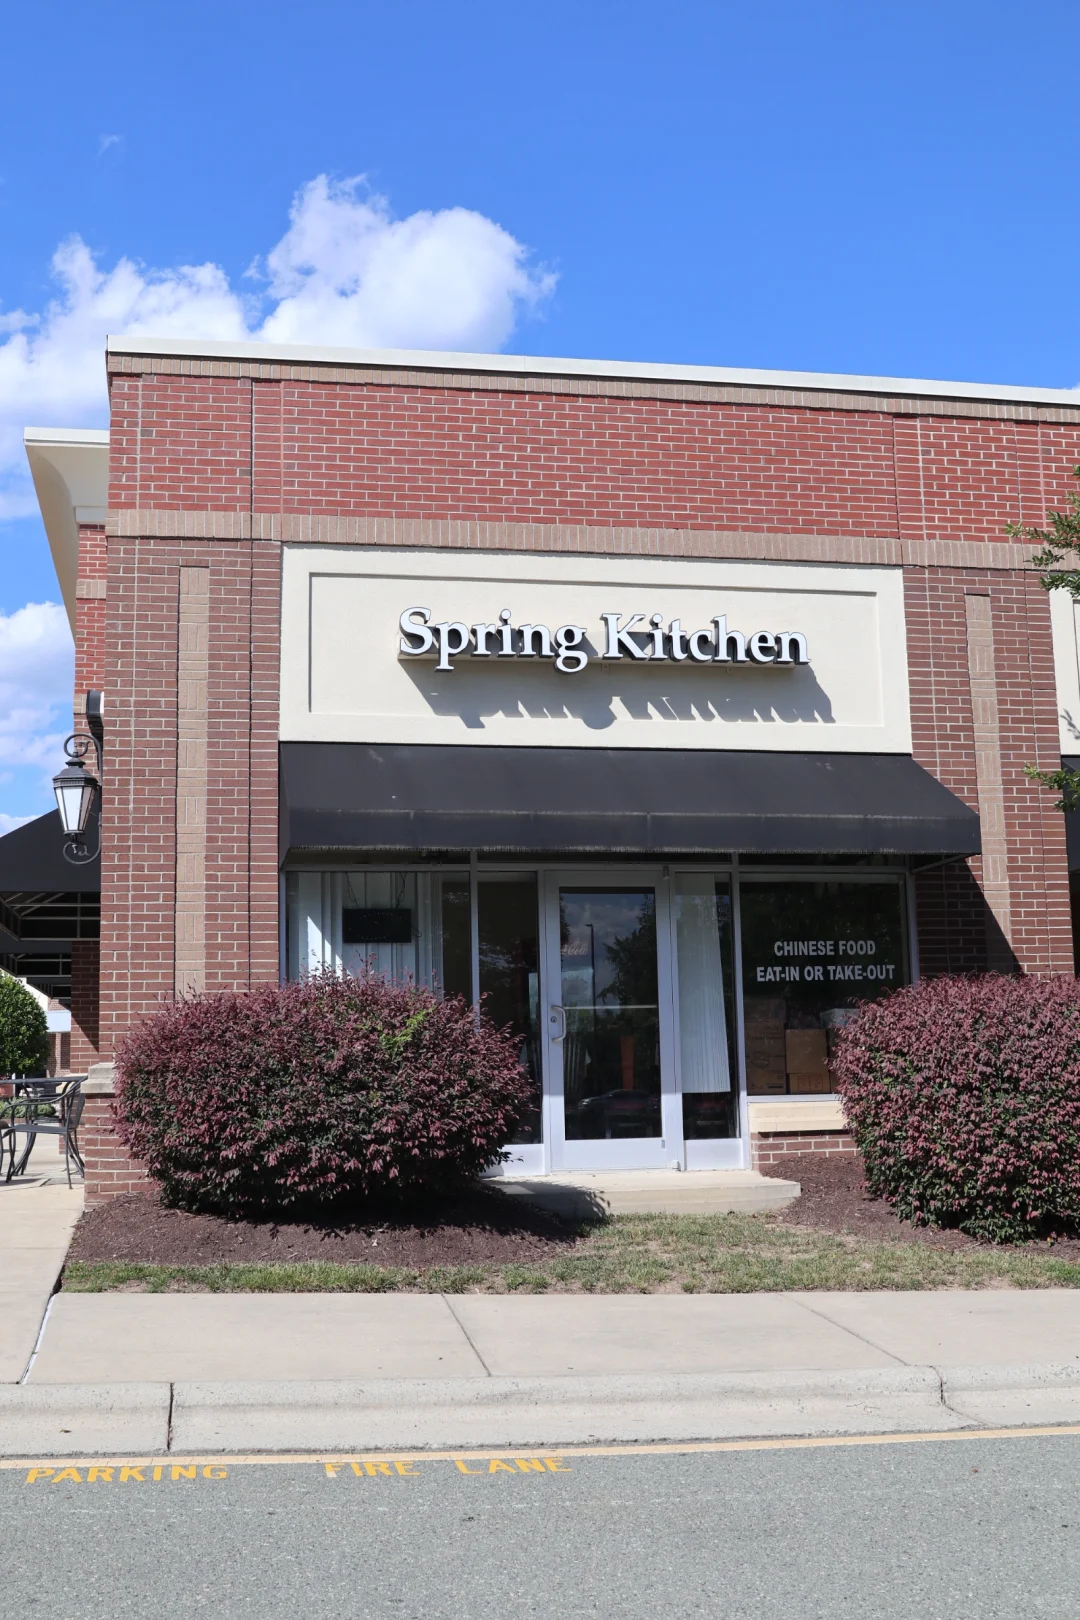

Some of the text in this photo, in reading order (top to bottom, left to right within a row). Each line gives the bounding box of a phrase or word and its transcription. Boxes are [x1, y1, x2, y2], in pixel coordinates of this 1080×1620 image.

[399, 606, 811, 674] Spring Kitchen
[773, 940, 876, 957] CHINESE FOOD
[756, 964, 895, 982] EAT-IN OR TAKE-OUT
[26, 1457, 573, 1484] PARKING FIRE LANE
